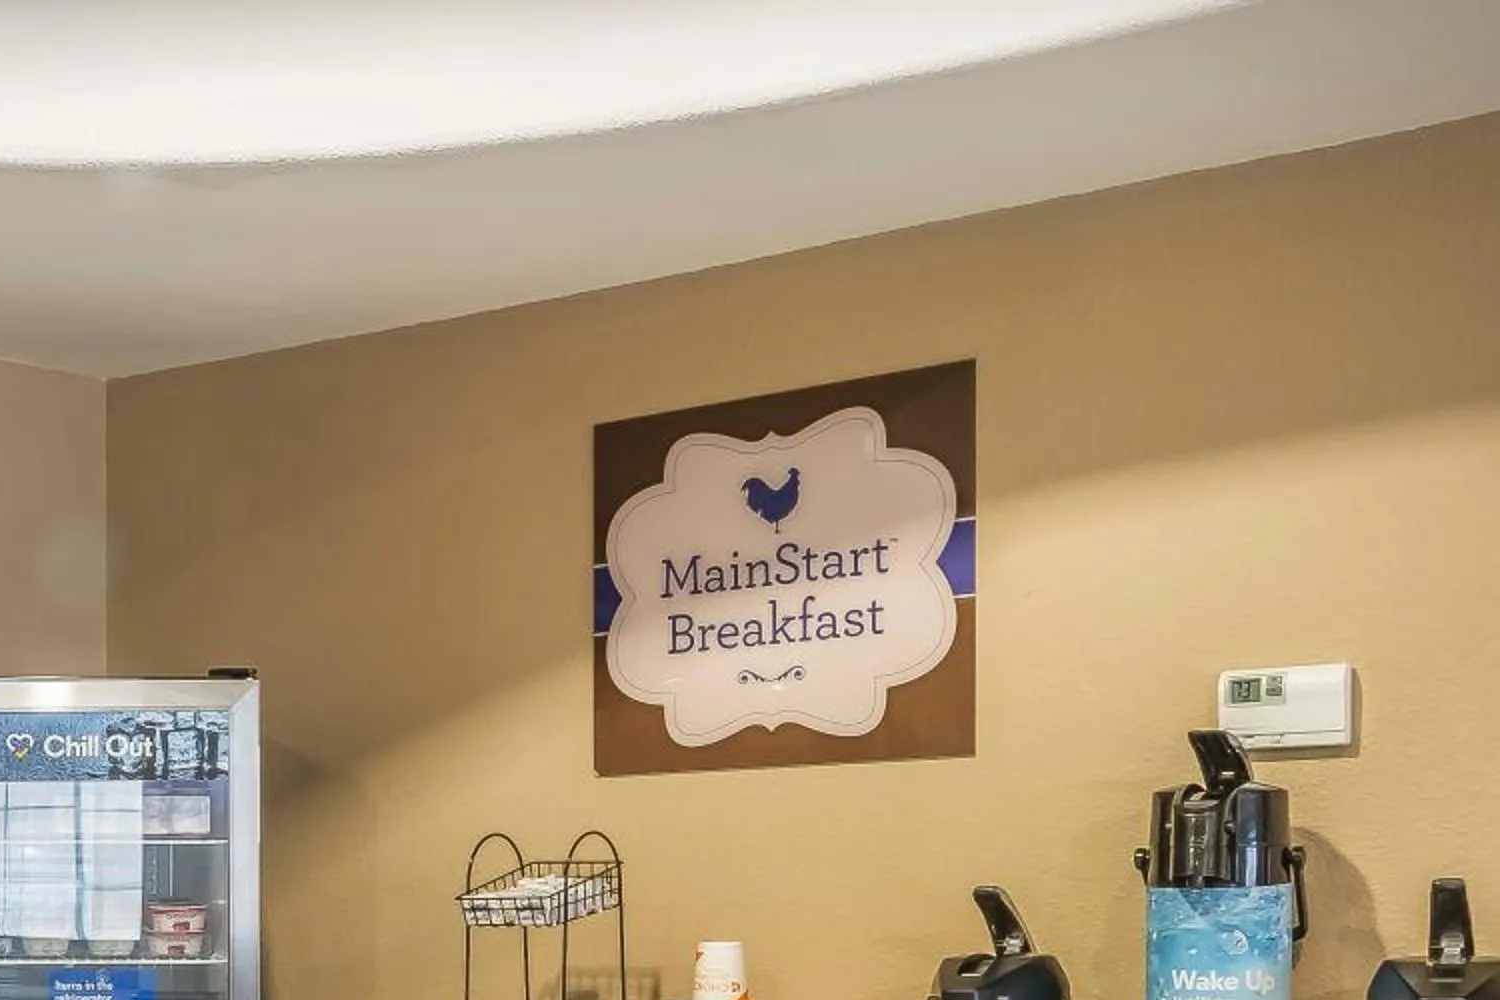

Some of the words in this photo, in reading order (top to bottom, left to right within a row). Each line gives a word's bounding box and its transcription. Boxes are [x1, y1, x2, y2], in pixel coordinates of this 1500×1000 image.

[660, 538, 890, 598] MainStart
[667, 596, 885, 655] Breakfast
[43, 733, 100, 758] Chill
[105, 733, 154, 758] Out
[85, 980, 95, 991] in
[97, 980, 114, 991] the
[1171, 969, 1239, 991] Wake
[1245, 969, 1276, 995] Up
